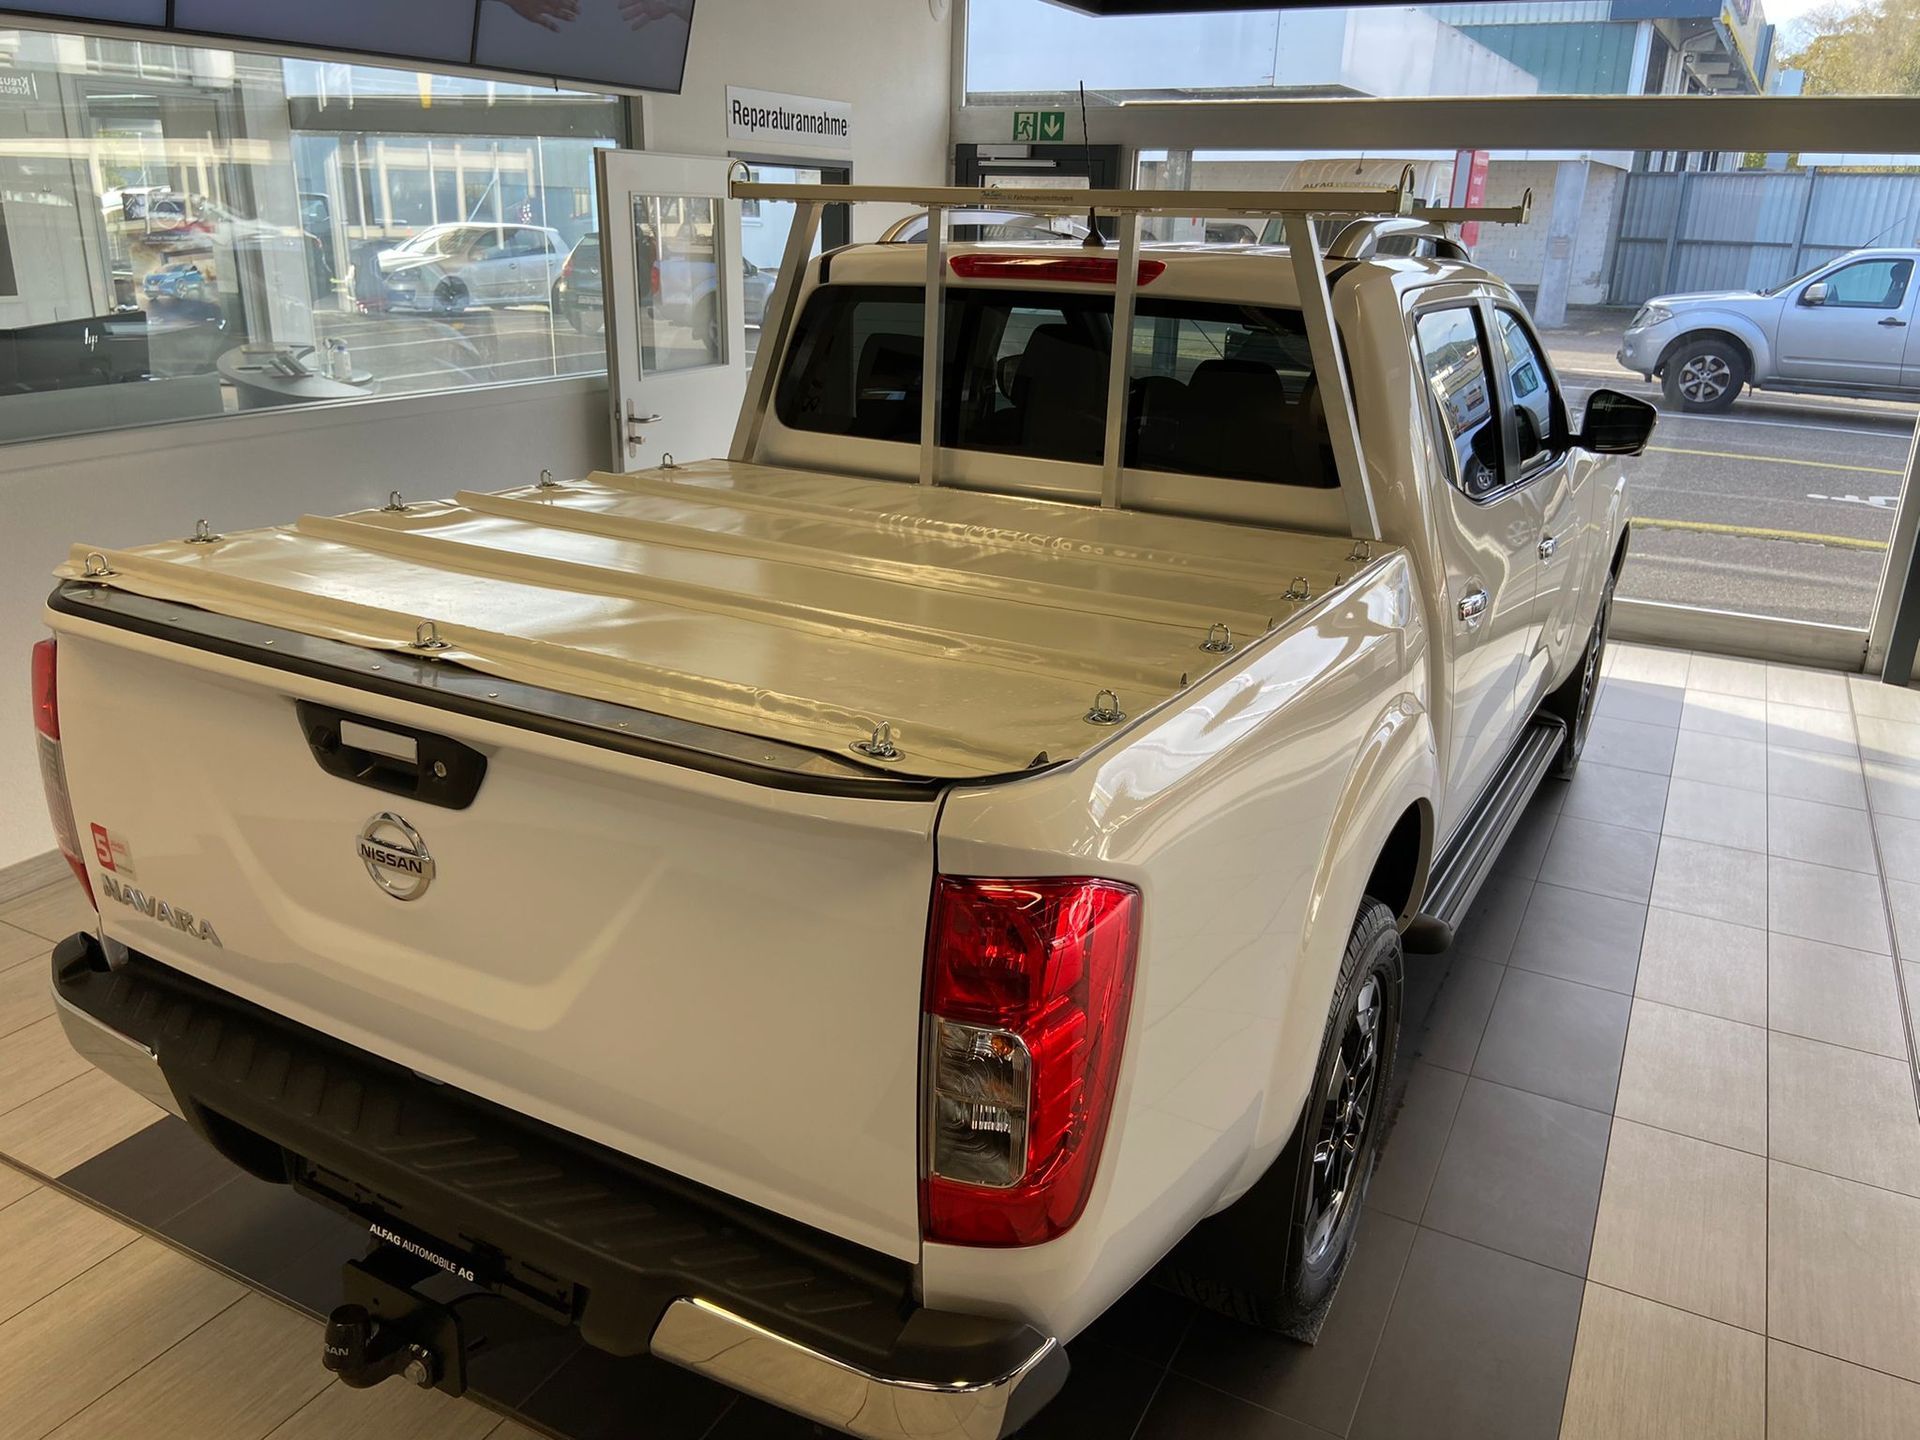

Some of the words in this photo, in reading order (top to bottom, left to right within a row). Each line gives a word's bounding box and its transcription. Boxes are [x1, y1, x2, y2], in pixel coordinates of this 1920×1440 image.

[732, 99, 848, 137] Reparaturannahme
[361, 843, 423, 874] NISSAN
[101, 873, 223, 949] NAVARA
[369, 1223, 401, 1246] ALFAG
[402, 1239, 457, 1273] AUTOMOBILE
[458, 1266, 475, 1282] AG
